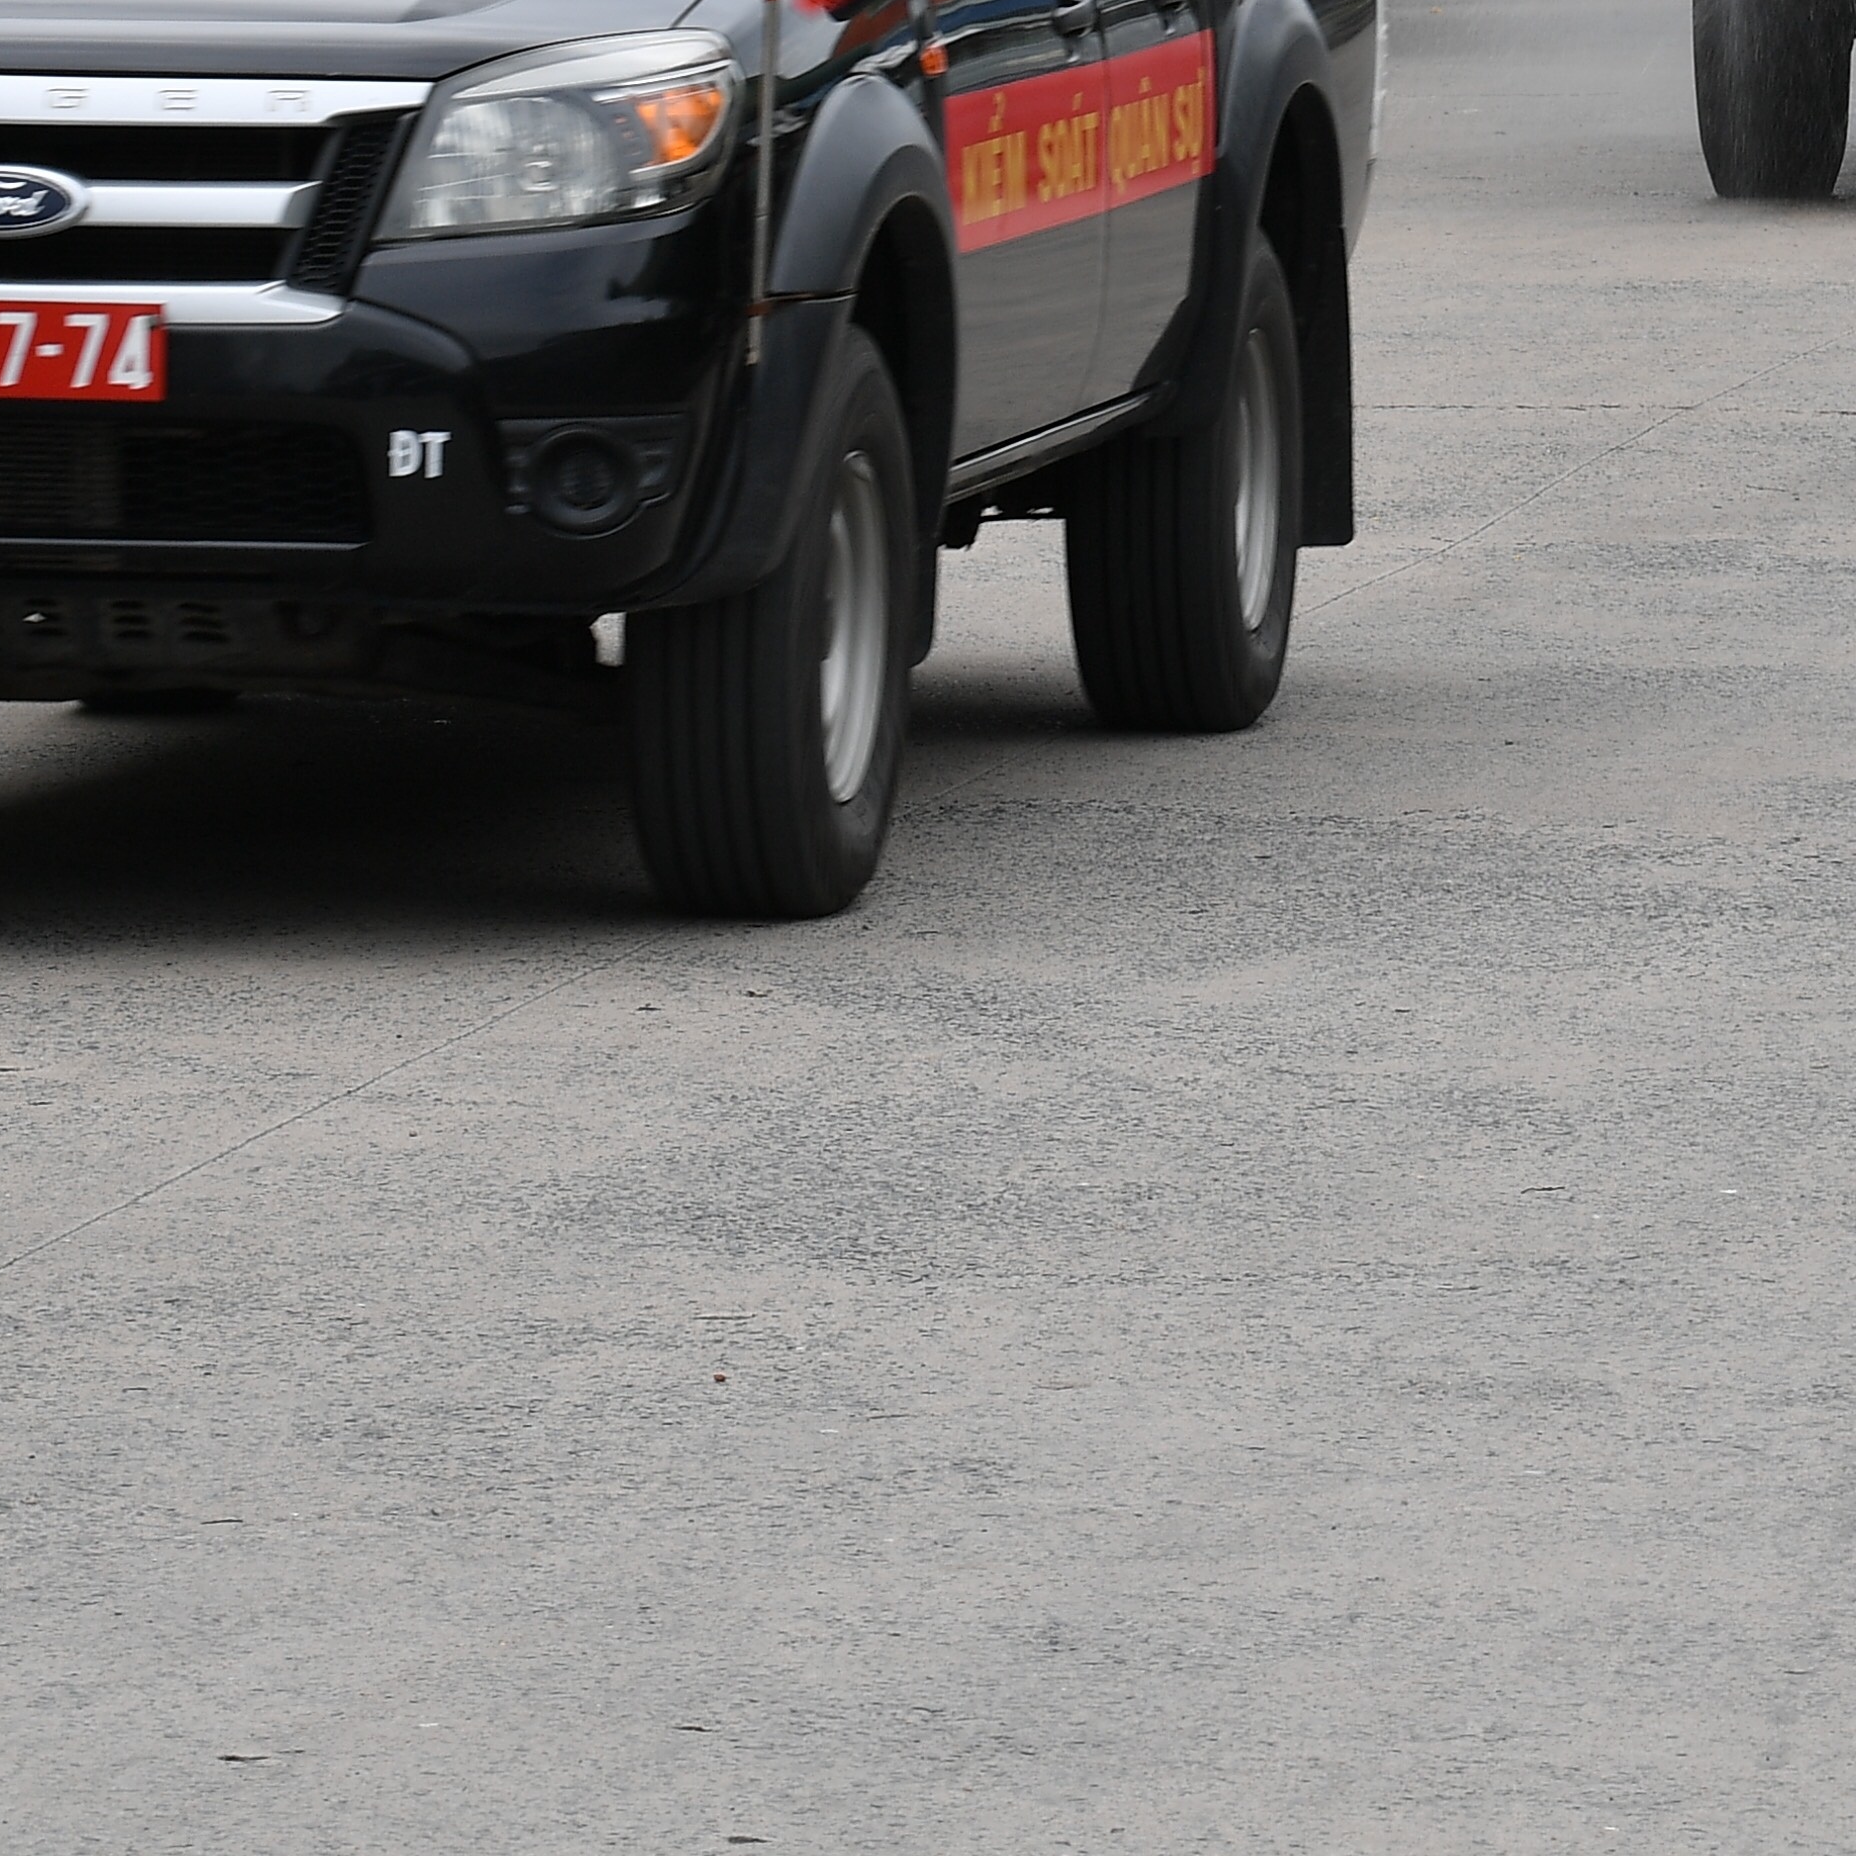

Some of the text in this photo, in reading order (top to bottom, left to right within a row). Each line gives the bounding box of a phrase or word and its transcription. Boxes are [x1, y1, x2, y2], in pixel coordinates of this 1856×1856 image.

[961, 66, 1207, 226] KIỂM SOÁT QUÂN SỰ
[387, 429, 452, 479] ĐT
